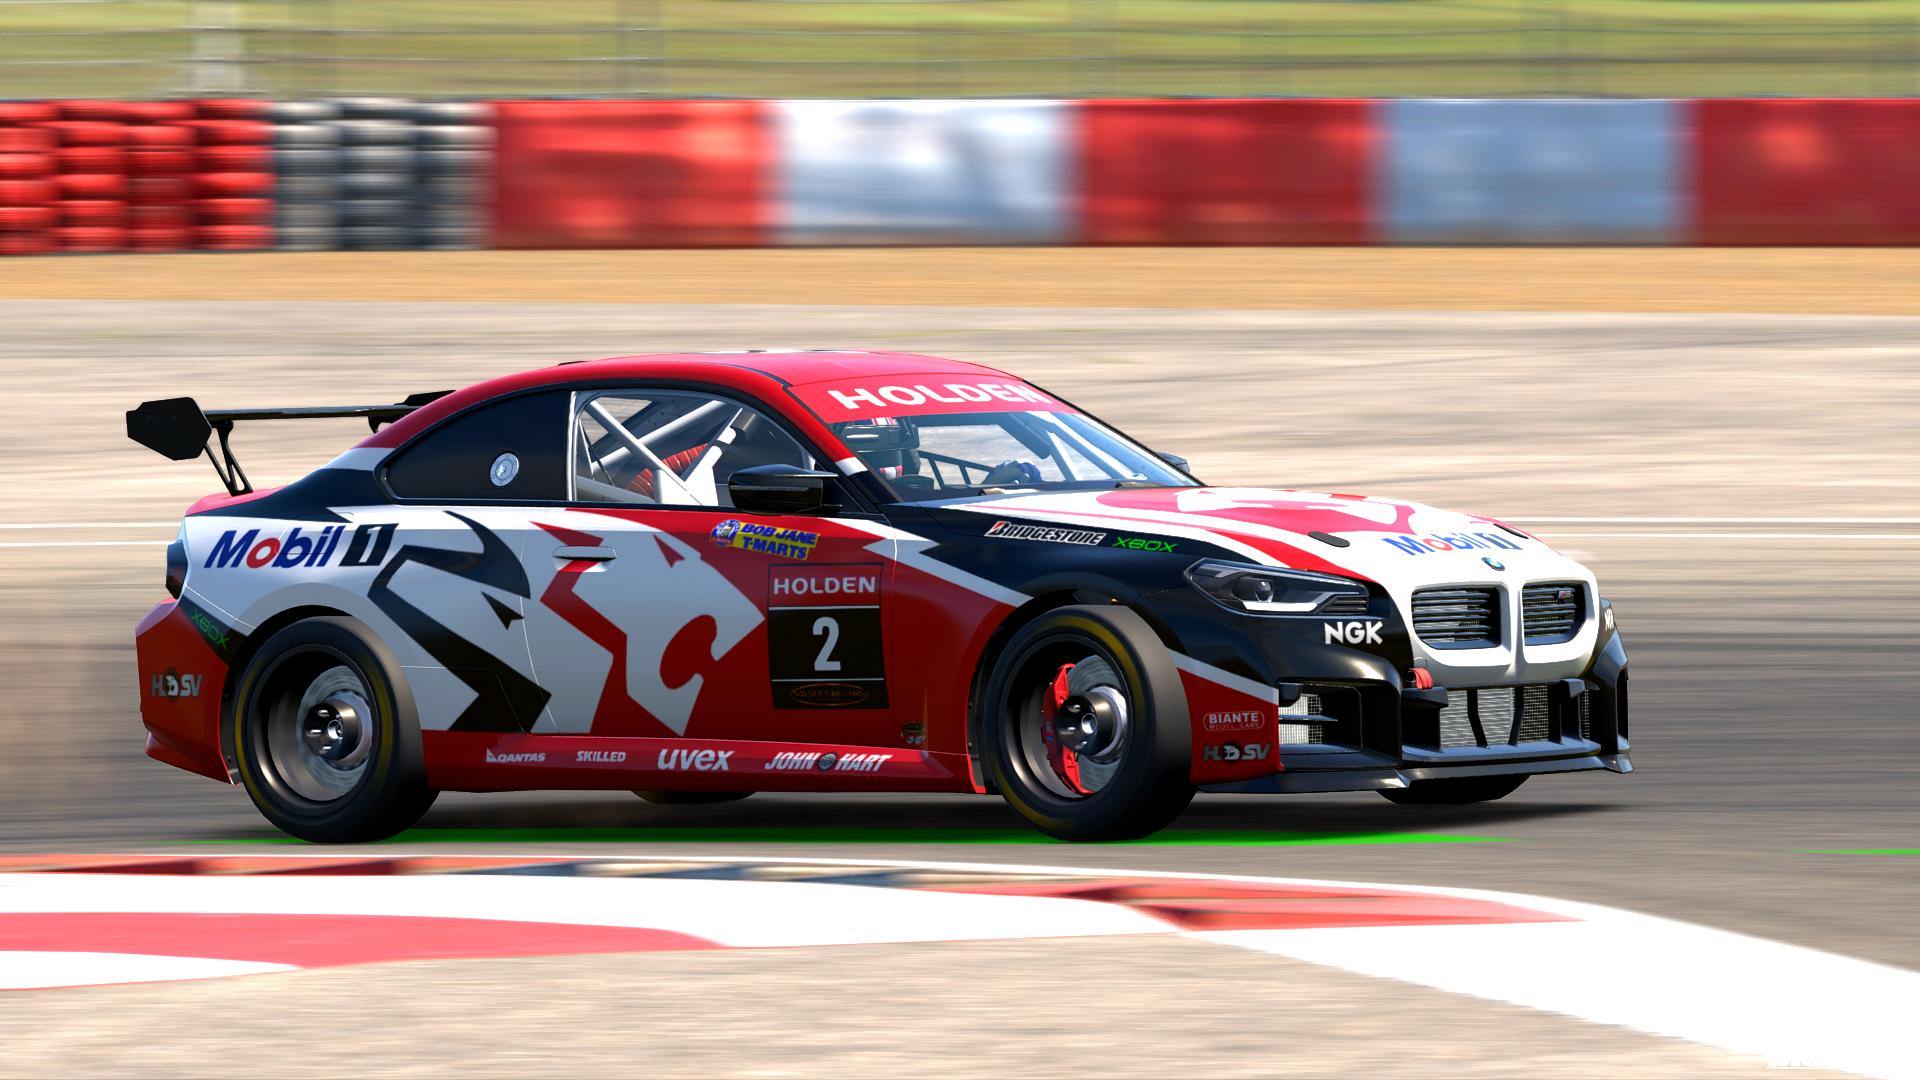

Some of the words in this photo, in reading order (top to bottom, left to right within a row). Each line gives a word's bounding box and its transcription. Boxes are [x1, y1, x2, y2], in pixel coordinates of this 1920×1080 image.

[827, 383, 1053, 409] HOLDEN
[741, 523, 776, 537] BOB
[775, 530, 817, 545] JANE
[984, 521, 1106, 545] BRIDGESTONE
[1381, 533, 1491, 556] Mobil
[203, 525, 346, 568] Mobil
[1112, 537, 1179, 553] XBOX
[773, 576, 876, 594] HOLDEN
[192, 608, 230, 650] XBOX
[1324, 620, 1383, 645] NGK
[812, 616, 842, 671] 2
[1208, 712, 1259, 724] BIANTE
[497, 752, 546, 763] QANTAS
[576, 751, 626, 763] SKILLED
[657, 748, 735, 771] uvex
[764, 751, 822, 771] JOHN
[834, 753, 893, 772] HART
